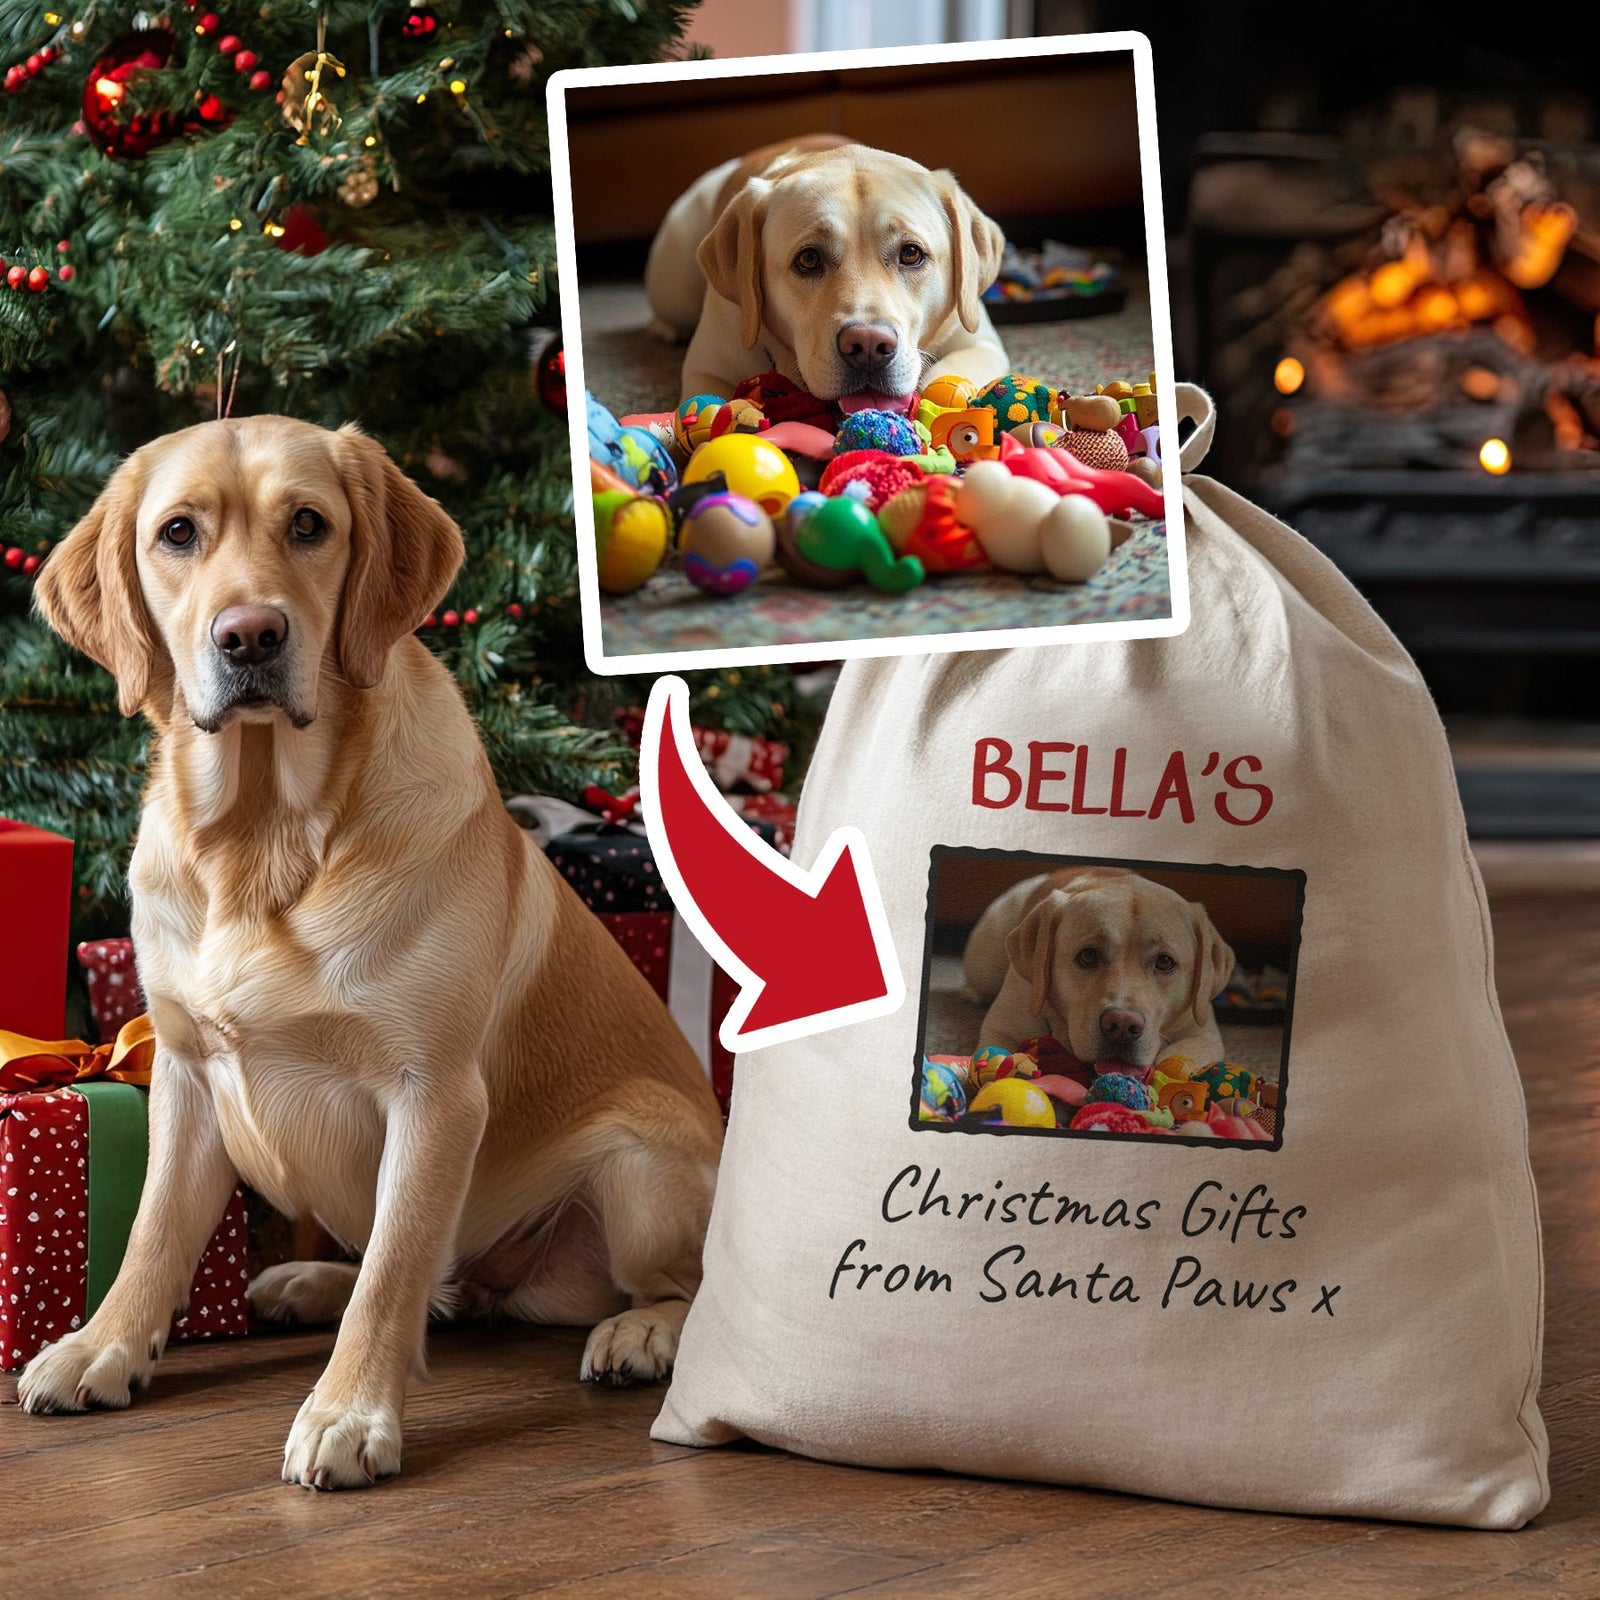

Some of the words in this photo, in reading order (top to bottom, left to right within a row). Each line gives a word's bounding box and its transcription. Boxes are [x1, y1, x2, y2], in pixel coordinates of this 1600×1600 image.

[971, 737, 1274, 826] BELLA'S
[881, 1164, 1162, 1231] Christmas
[1181, 1179, 1310, 1244] Gifts
[828, 1238, 952, 1300] from
[979, 1244, 1141, 1304] Santa
[1161, 1255, 1298, 1315] Paws
[1310, 1284, 1342, 1318] x
